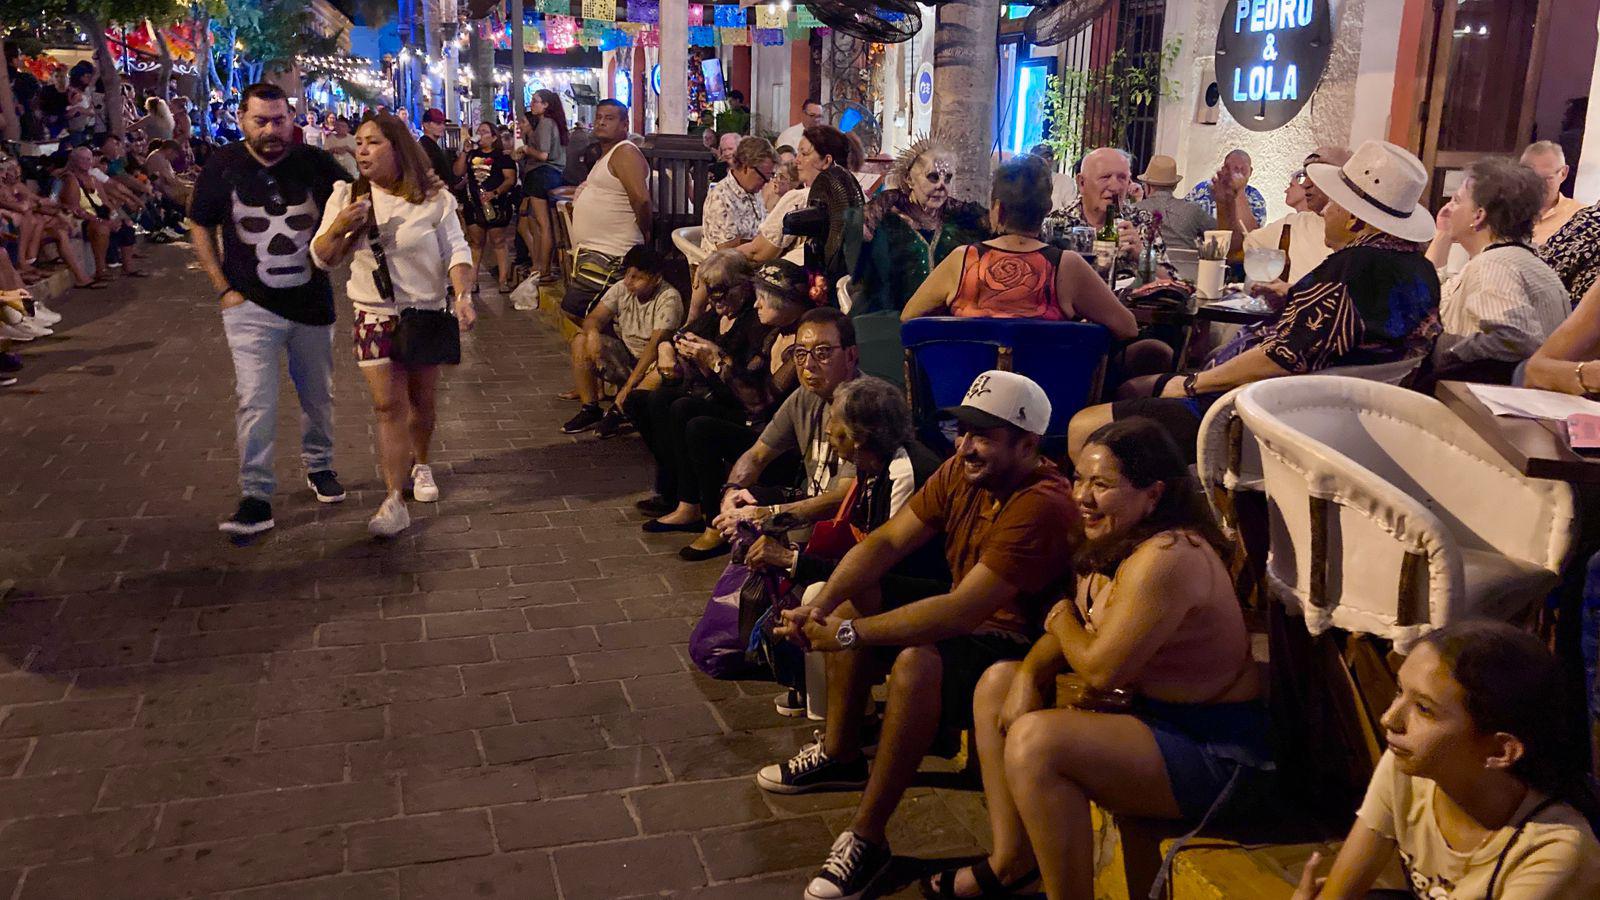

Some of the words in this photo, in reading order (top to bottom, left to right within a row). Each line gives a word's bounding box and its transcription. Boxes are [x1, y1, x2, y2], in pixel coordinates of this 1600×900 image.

[1235, 0, 1313, 33] PEDRO
[1263, 33, 1278, 61] &
[1233, 64, 1297, 102] LOLA
